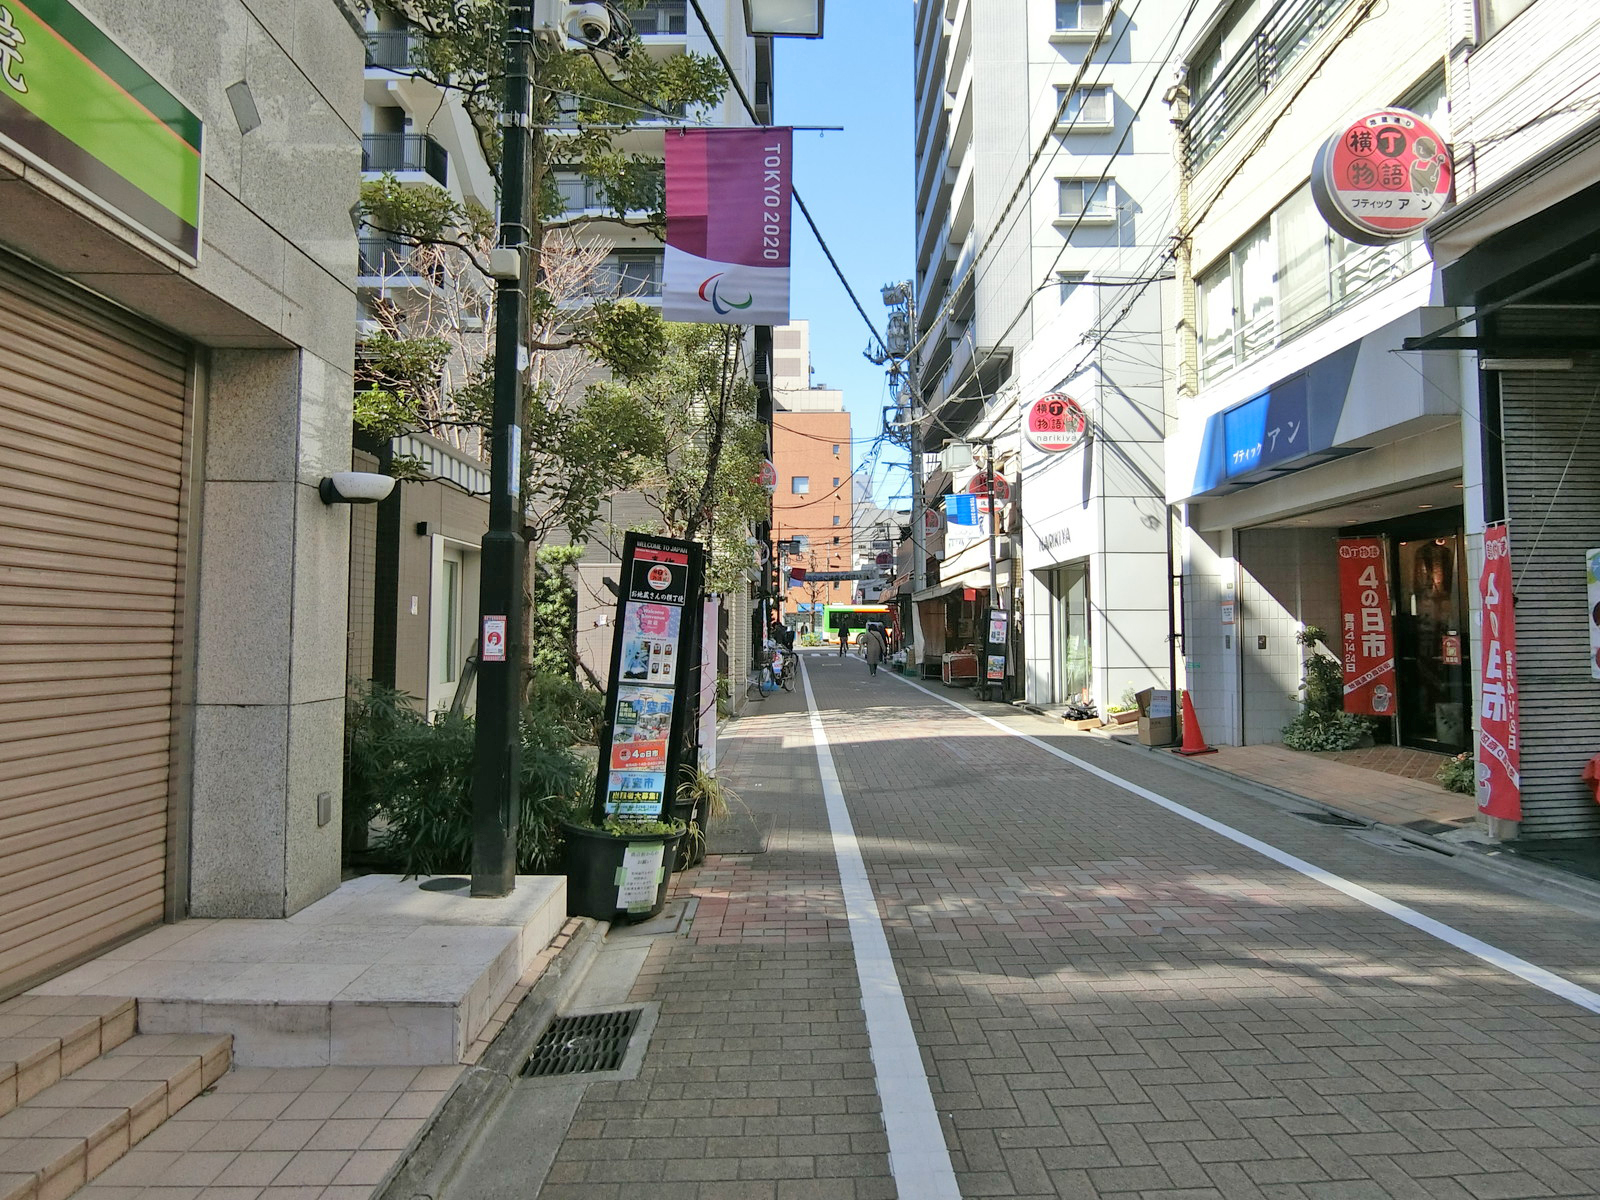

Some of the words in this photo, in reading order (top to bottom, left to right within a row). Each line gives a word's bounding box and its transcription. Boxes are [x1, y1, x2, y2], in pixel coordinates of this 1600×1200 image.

[763, 143, 781, 208] TOKYO
[1351, 162, 1404, 186] 物語
[1352, 198, 1393, 209] ブティック
[763, 211, 780, 260] 2020
[1036, 434, 1077, 443] narikiya
[1232, 442, 1263, 465] ブティック
[1267, 420, 1301, 453] アン
[636, 541, 662, 550] WELCOME
[670, 545, 688, 554] JAPAN
[1358, 565, 1387, 658] 4の日市
